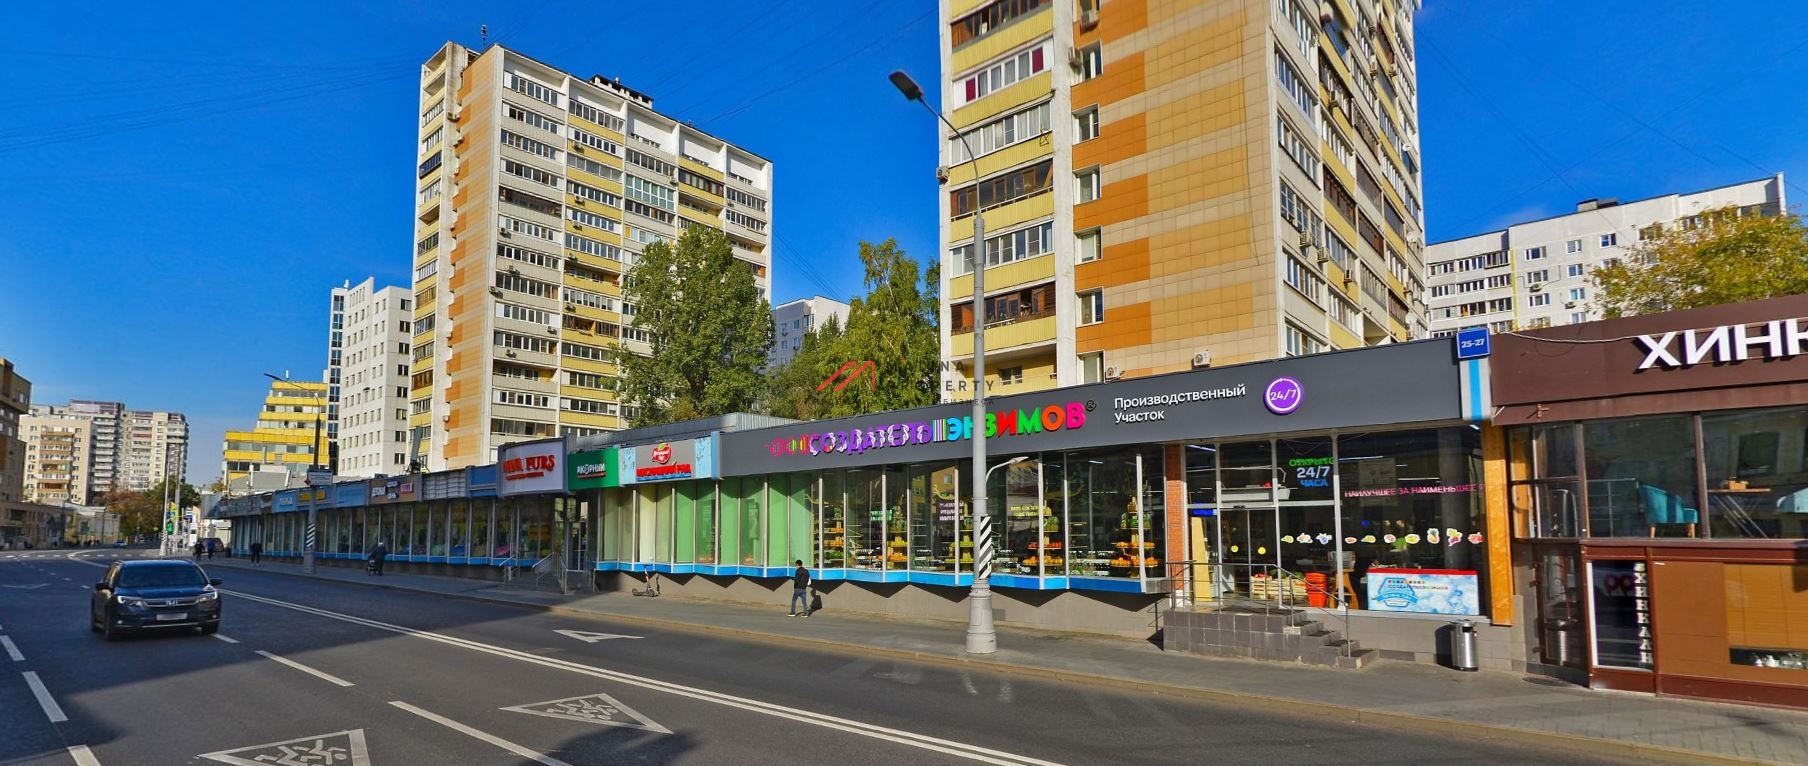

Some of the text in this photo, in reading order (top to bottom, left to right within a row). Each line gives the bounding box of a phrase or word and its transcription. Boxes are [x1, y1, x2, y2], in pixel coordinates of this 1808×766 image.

[1461, 338, 1485, 348] 25-27
[1114, 383, 1246, 410] Производственный
[1270, 388, 1297, 401] 24/7
[1114, 410, 1165, 424] Участок
[1296, 465, 1330, 478] 24/7
[1300, 479, 1329, 487] ЧАСА
[1344, 487, 1396, 497] НАИЛУЧШЕЕ
[1398, 487, 1409, 495] ЗА
[1411, 483, 1477, 494] НАИМЕНЬШЕЕ
